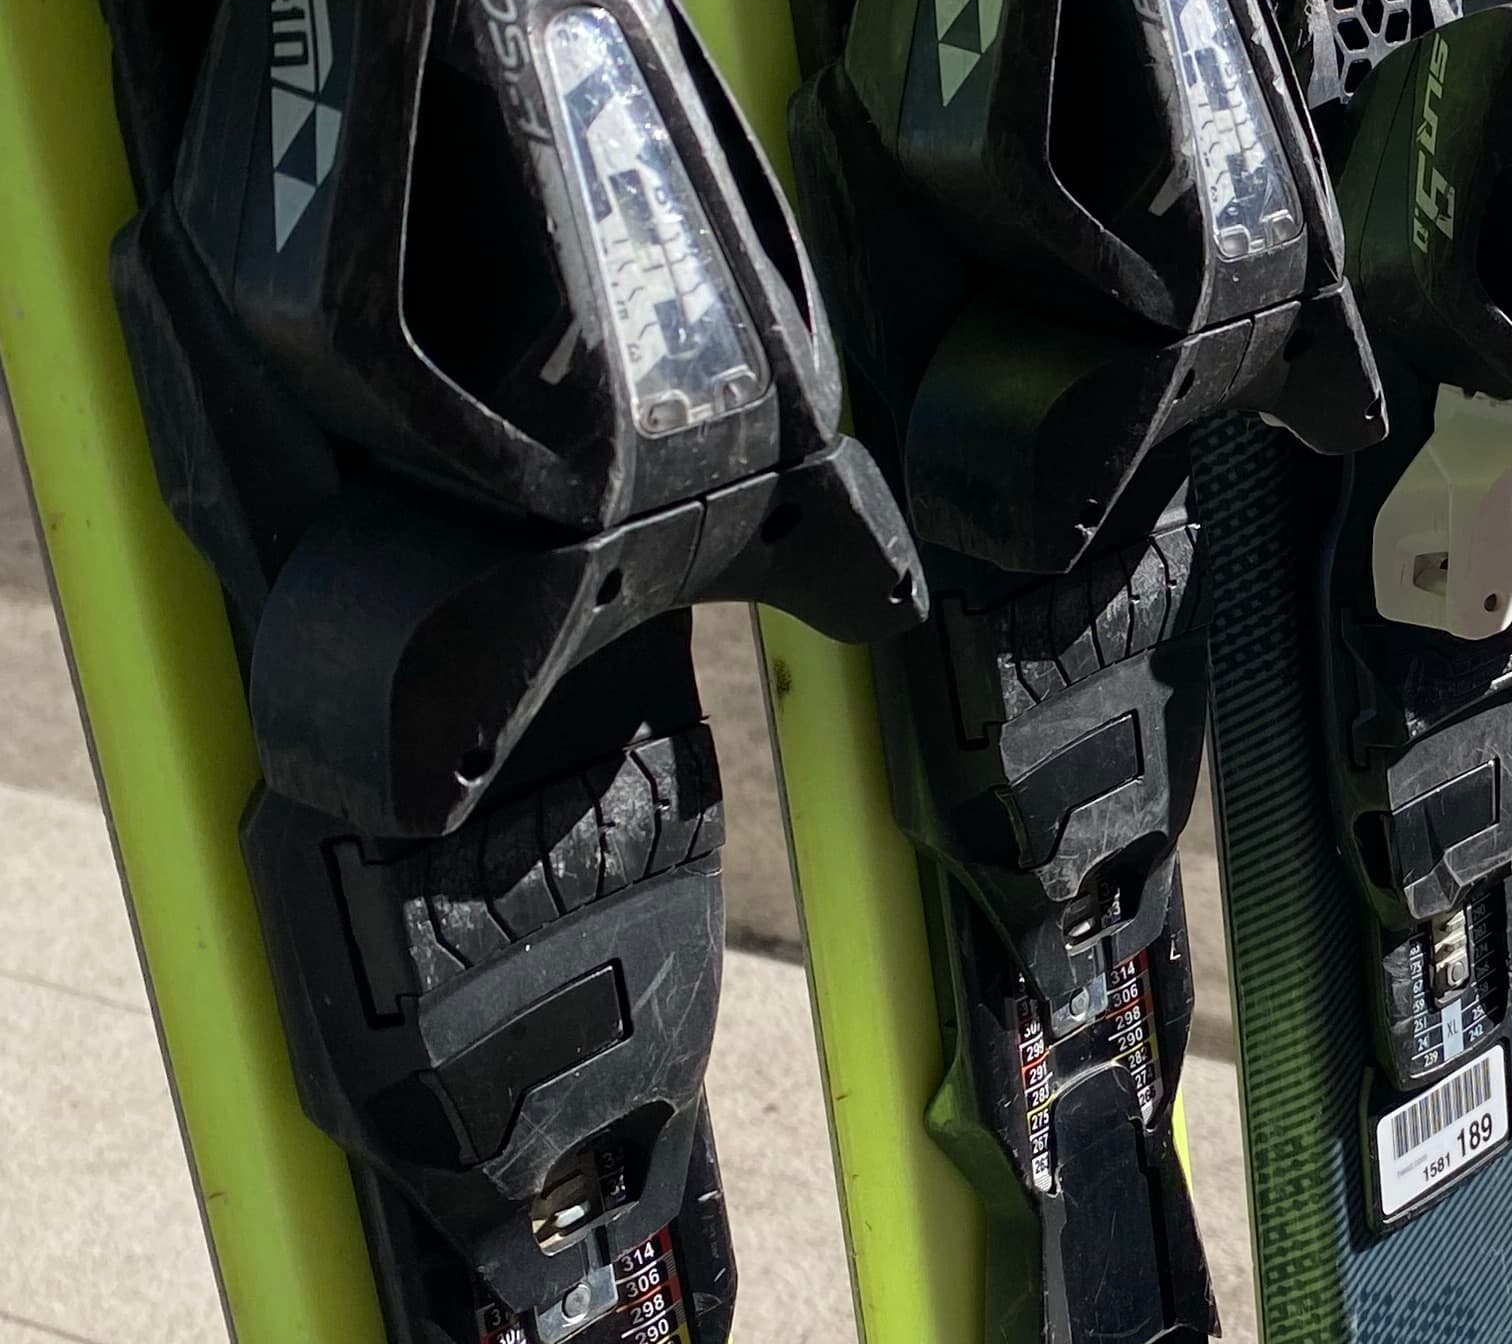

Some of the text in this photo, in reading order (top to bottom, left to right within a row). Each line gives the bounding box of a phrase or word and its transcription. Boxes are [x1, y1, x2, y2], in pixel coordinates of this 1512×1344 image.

[1415, 31, 1449, 156] SLR
[1110, 961, 1136, 986] 314
[1112, 984, 1139, 1007] 306
[1115, 1006, 1141, 1031] 298
[1447, 1012, 1459, 1038] XL
[1118, 1028, 1144, 1052] 290
[1029, 1062, 1048, 1085] 291
[1031, 1108, 1050, 1131] 275
[1032, 1132, 1049, 1154] 267
[1423, 1151, 1451, 1183] 1581
[1457, 1112, 1493, 1158] 189
[622, 1241, 655, 1273] 314
[626, 1269, 661, 1298] 306
[630, 1293, 665, 1324] 298
